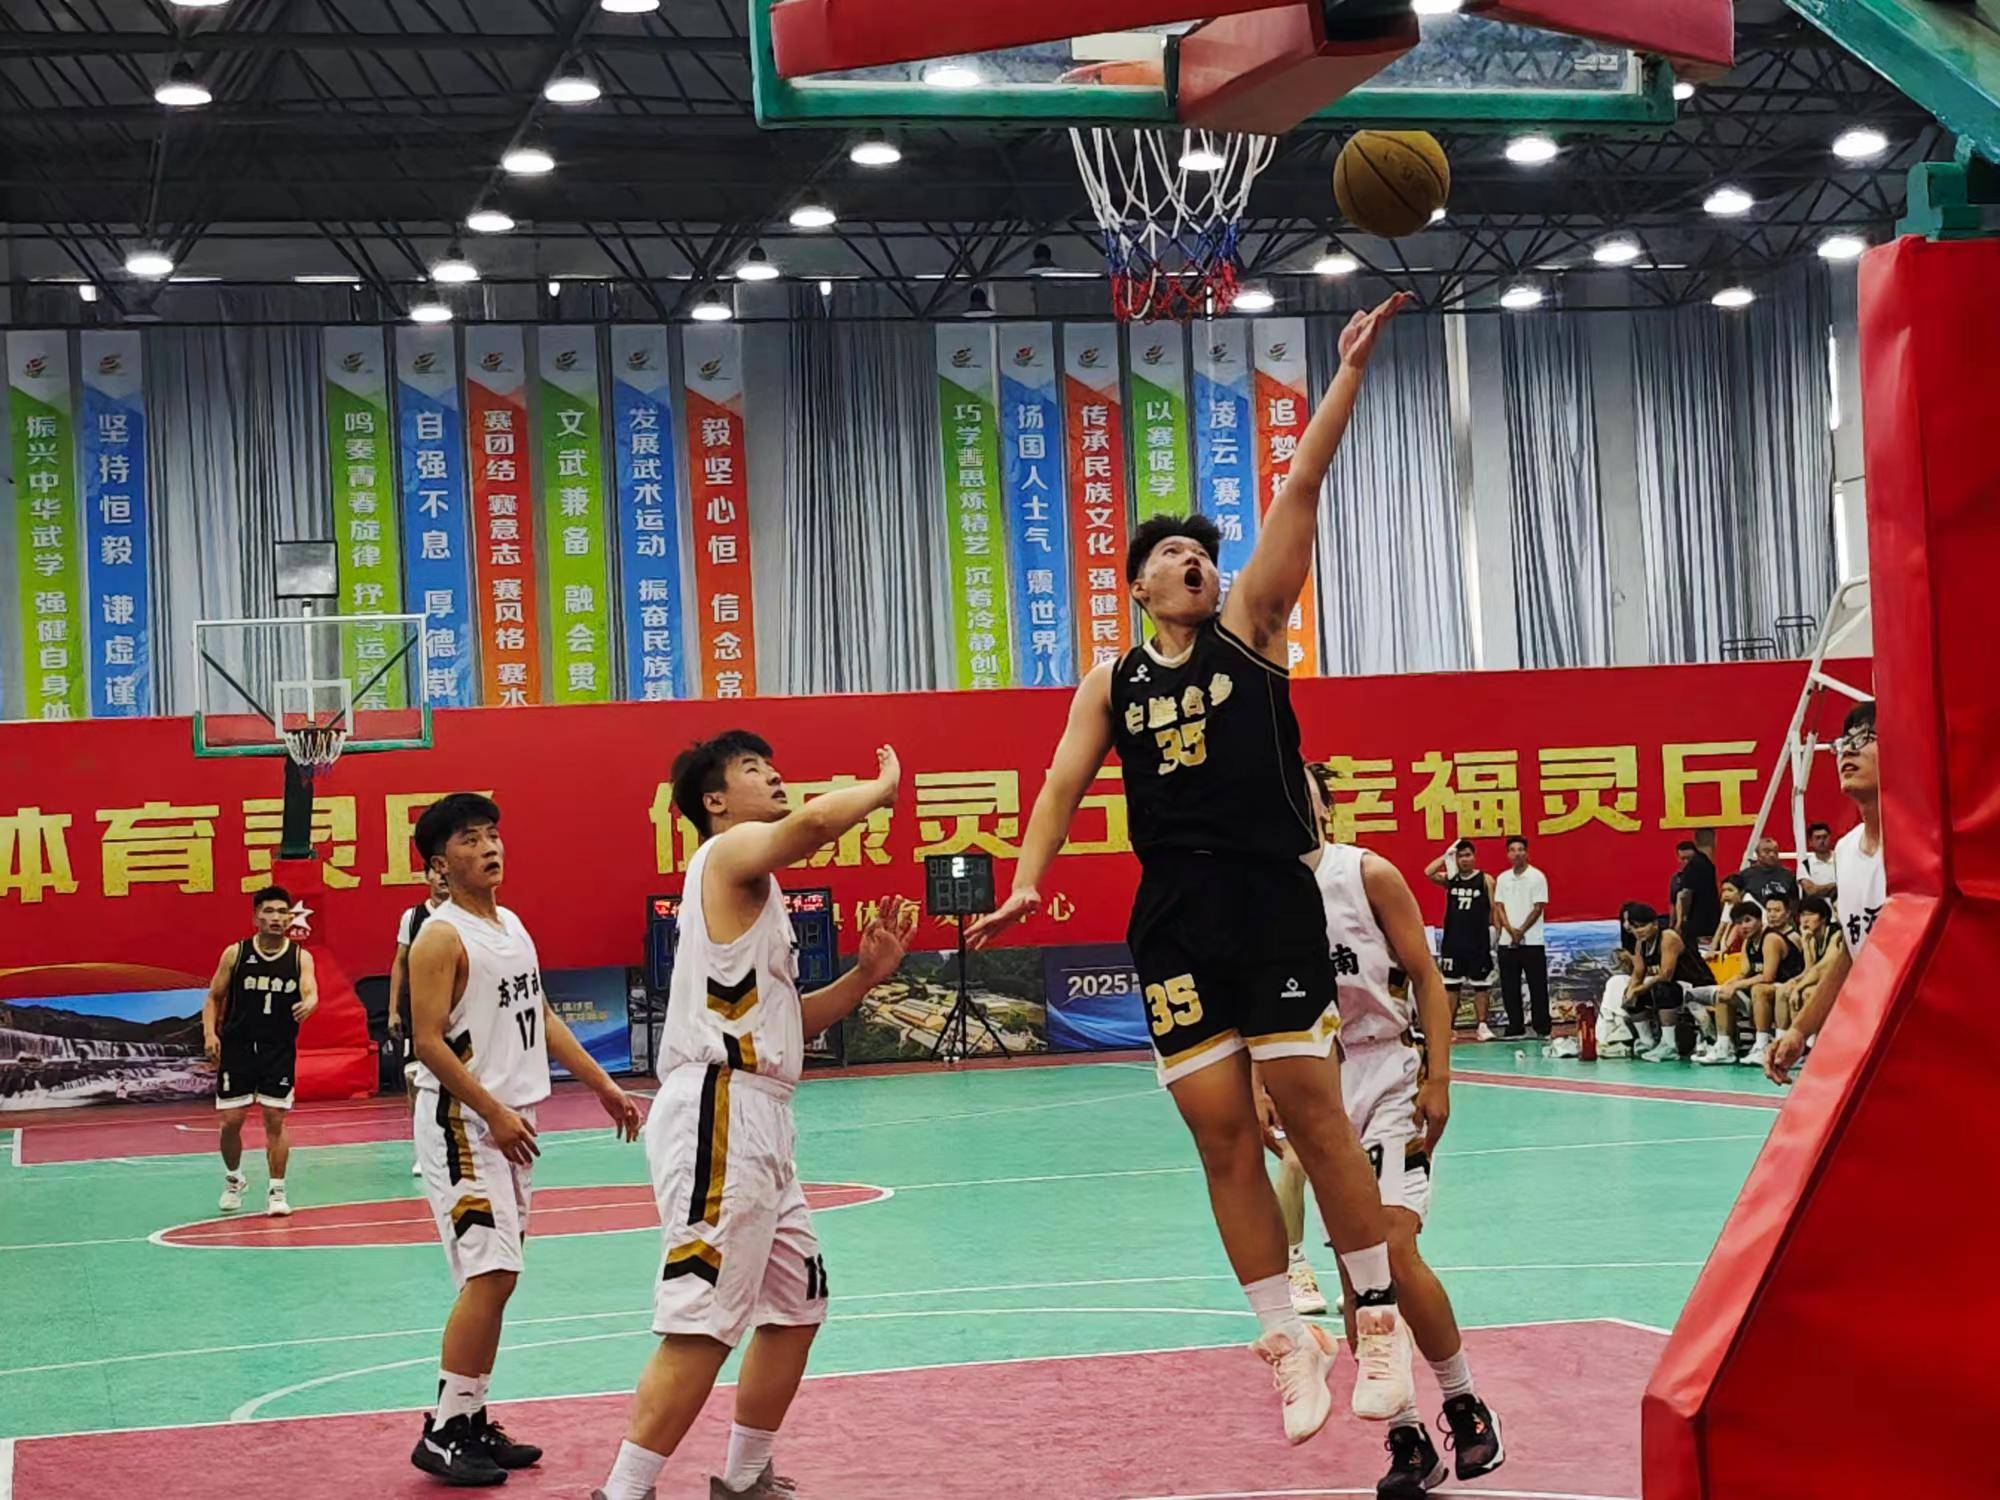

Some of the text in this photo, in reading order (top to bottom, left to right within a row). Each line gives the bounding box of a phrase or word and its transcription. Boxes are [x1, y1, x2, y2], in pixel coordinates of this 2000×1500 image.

[27, 416, 64, 577] 振兴中华武学
[344, 411, 381, 568] 鸣奏青春旋律
[629, 404, 667, 558] 发展武术运动
[702, 418, 738, 566] 毅坚心恒
[1081, 404, 1116, 556] 传承民族文化
[1146, 401, 1176, 497] 以赛促学
[99, 415, 137, 705] 坚持恒毅 谦虚谨
[415, 410, 458, 698] 自强不息 厚德载
[556, 409, 597, 692] 文武兼备 融会贯
[1018, 405, 1063, 685] 扬国人士气 震世界八
[1155, 718, 1207, 775] 35
[1457, 897, 1472, 910] 77
[263, 992, 272, 1014] 1
[515, 1007, 536, 1051] 17
[1145, 973, 1203, 1036] 35
